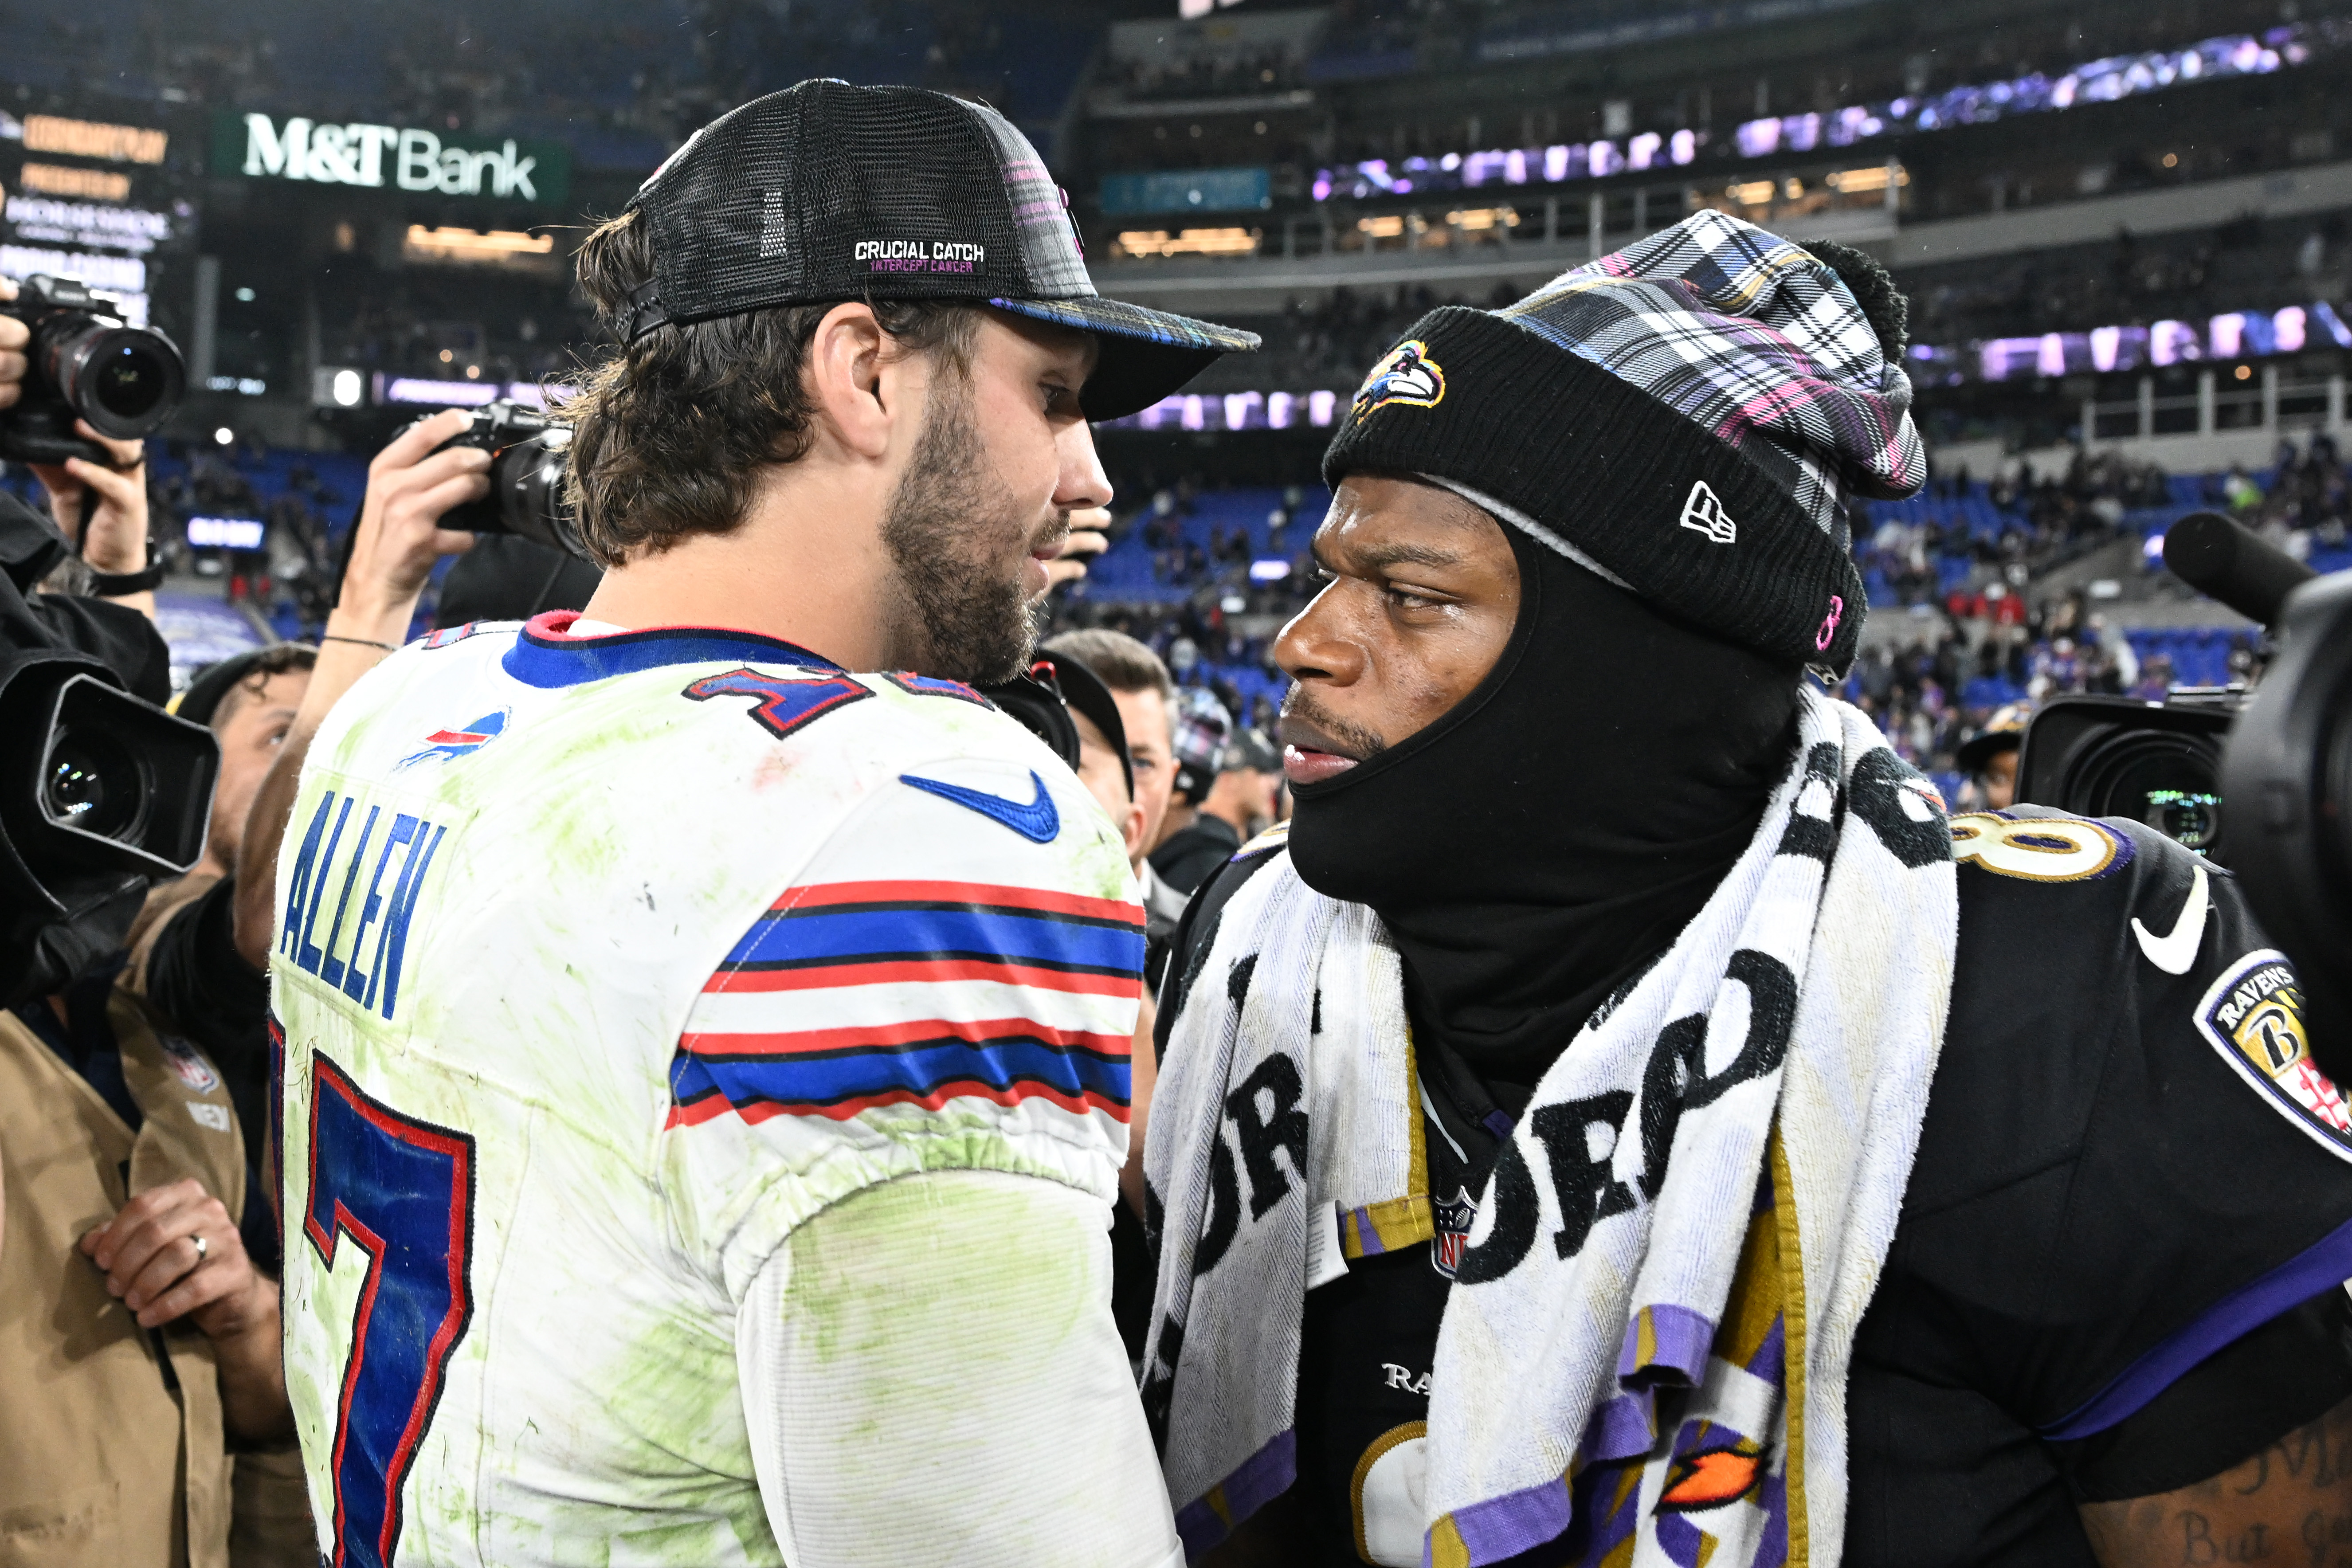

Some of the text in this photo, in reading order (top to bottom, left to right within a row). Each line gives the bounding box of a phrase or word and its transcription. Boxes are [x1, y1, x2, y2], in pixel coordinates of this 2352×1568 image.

[855, 240, 984, 263] CRUCIAL CATCH
[870, 259, 973, 273] INTERCEPT CANCER
[1950, 809, 2136, 883] 8
[279, 790, 447, 1021] ALLEN
[2217, 966, 2295, 1030] RAVENS
[268, 1004, 477, 1568] 7
